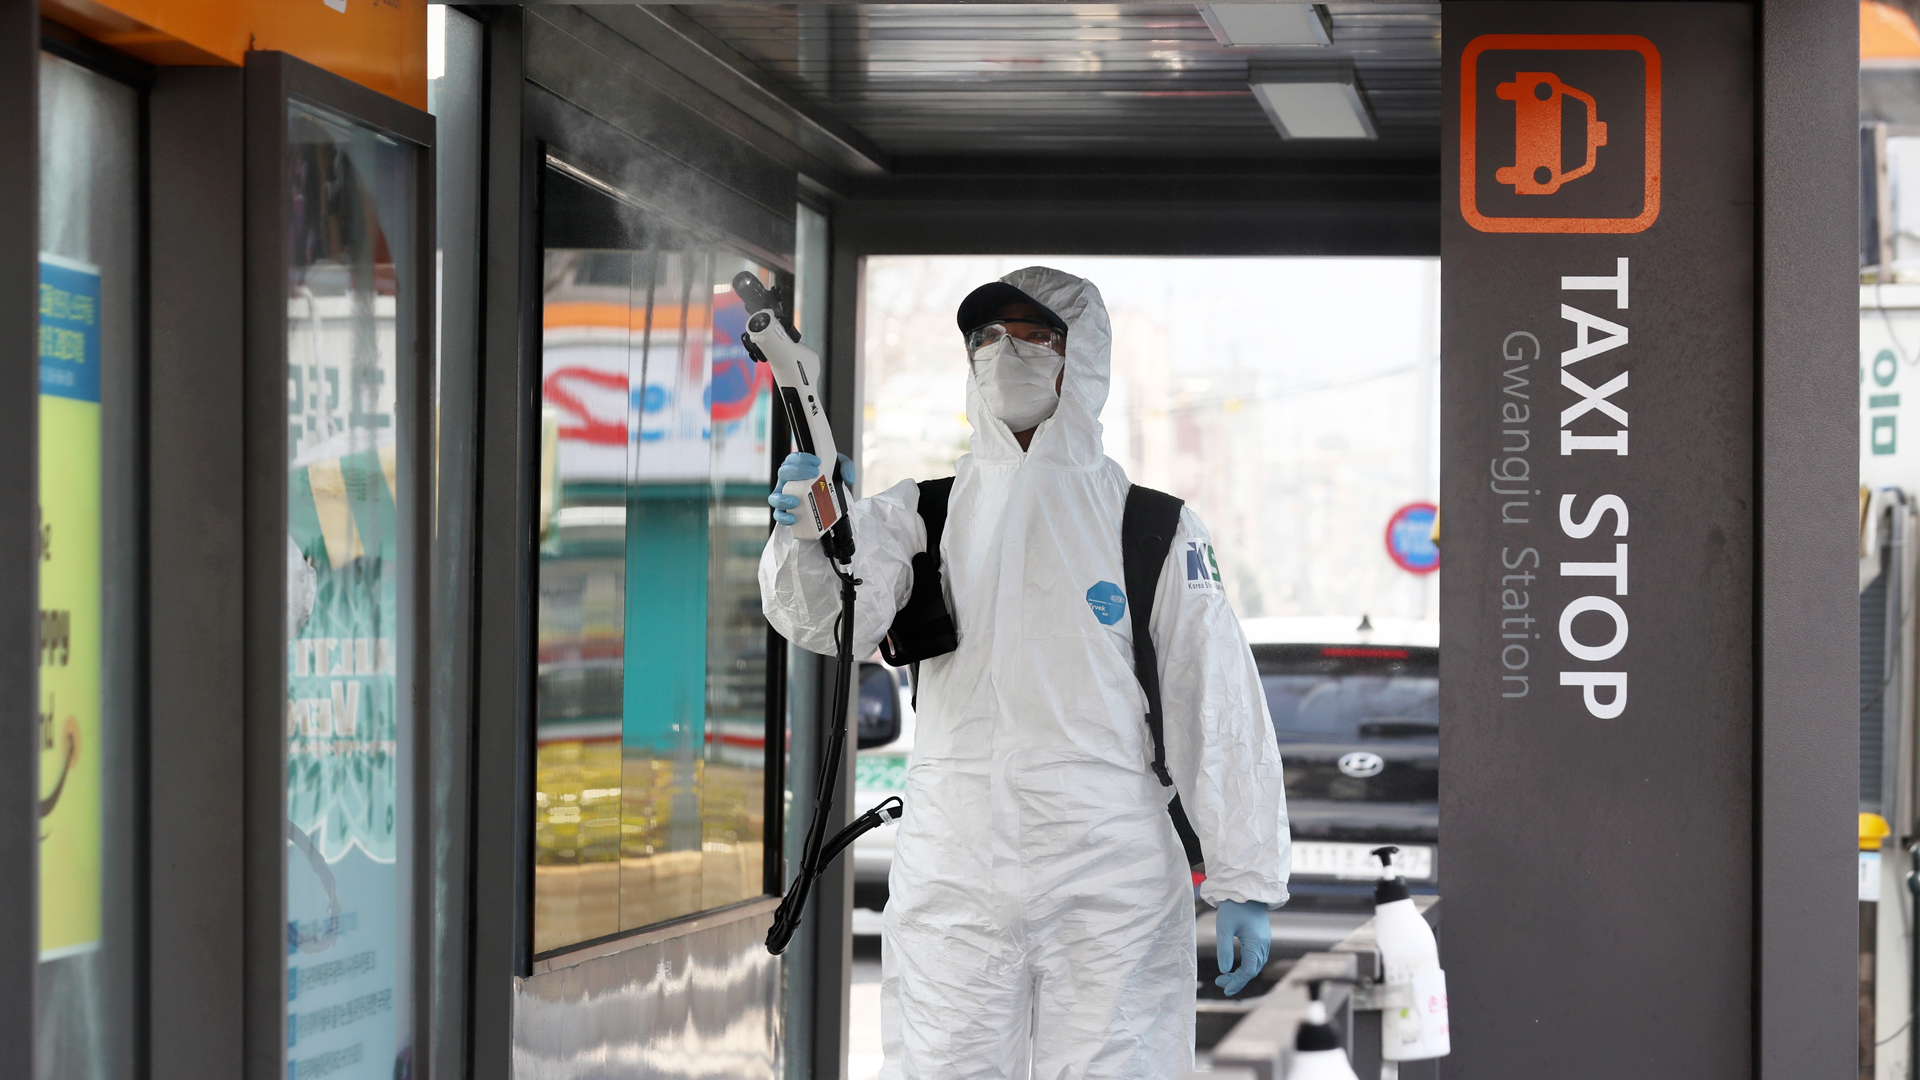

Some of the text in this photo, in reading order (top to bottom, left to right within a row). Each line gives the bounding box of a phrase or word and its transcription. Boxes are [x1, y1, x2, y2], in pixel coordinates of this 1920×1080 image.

[1188, 581, 1205, 590] Korea
[1490, 330, 1541, 699] Gwangju Station
[1559, 257, 1629, 720] TAXI STOP
